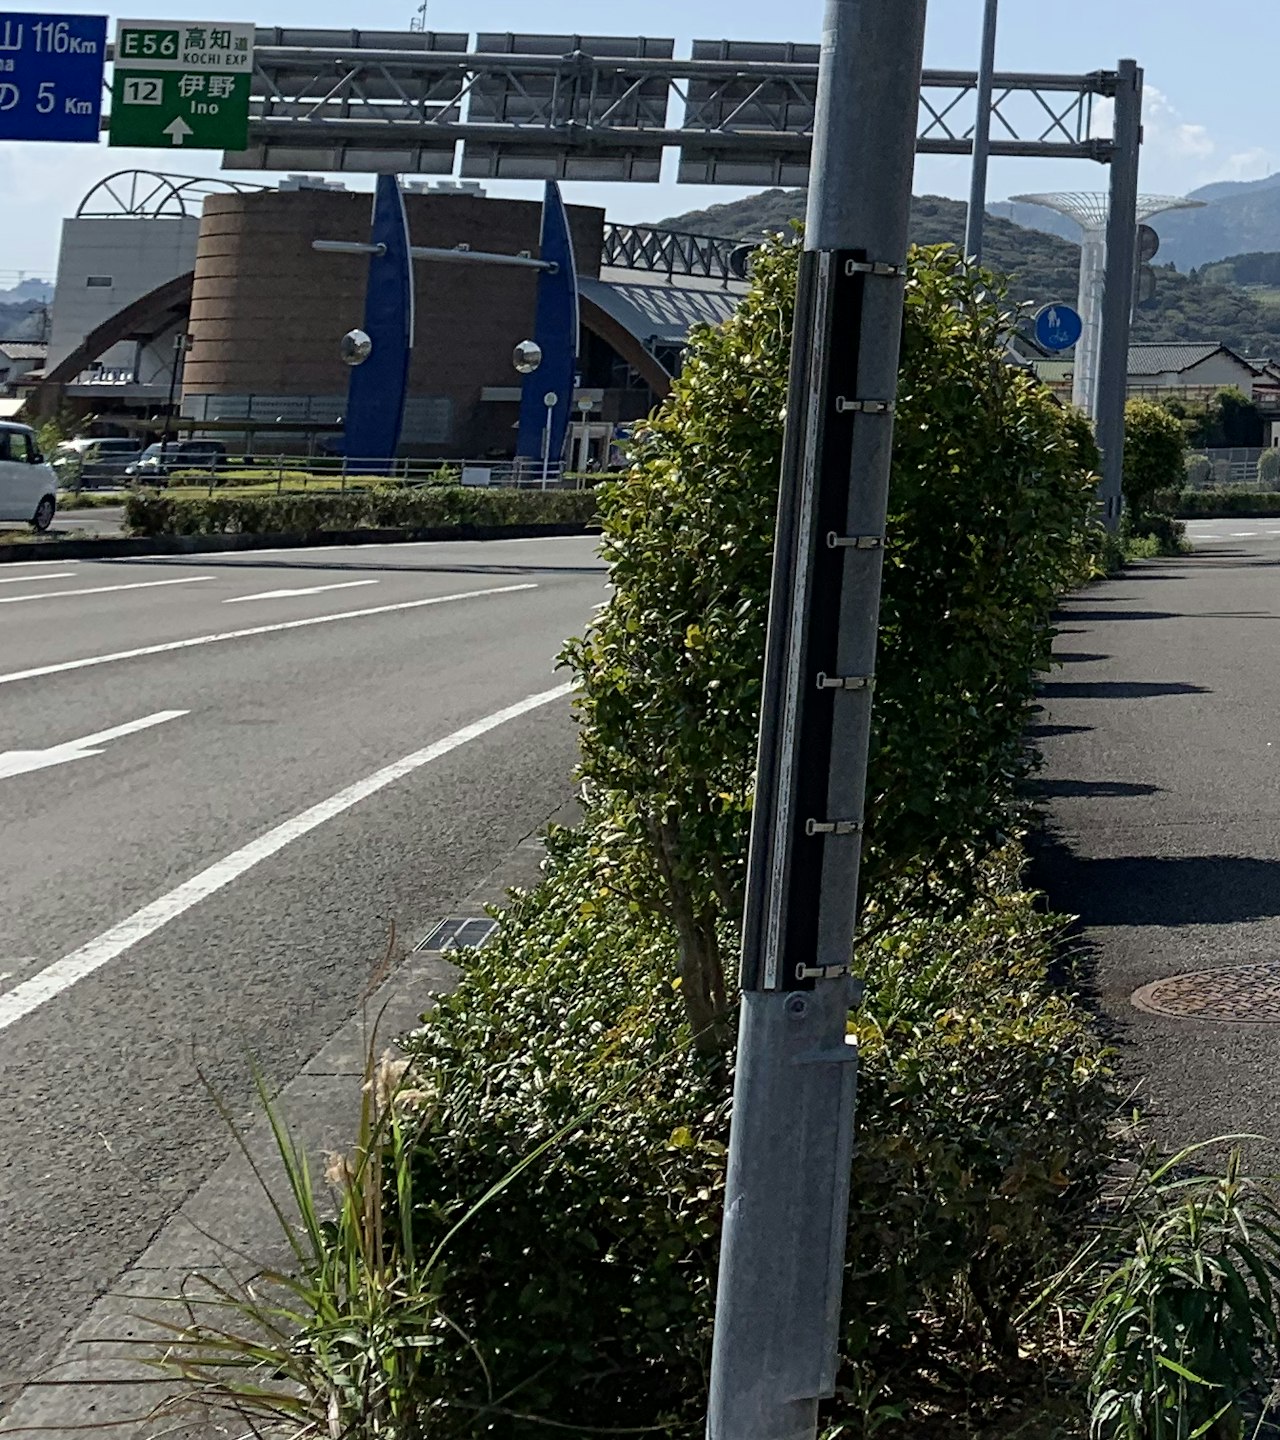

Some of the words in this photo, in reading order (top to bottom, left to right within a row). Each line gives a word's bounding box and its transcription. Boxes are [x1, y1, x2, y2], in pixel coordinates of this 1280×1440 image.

[125, 33, 175, 55] E56
[184, 27, 248, 51] 高知道
[183, 53, 220, 64] KOCHI
[225, 54, 247, 65] EXP
[128, 81, 157, 101] 12
[178, 74, 235, 99] 伊野
[36, 82, 55, 113] 5
[64, 97, 93, 114] Km
[191, 100, 219, 114] Ino
